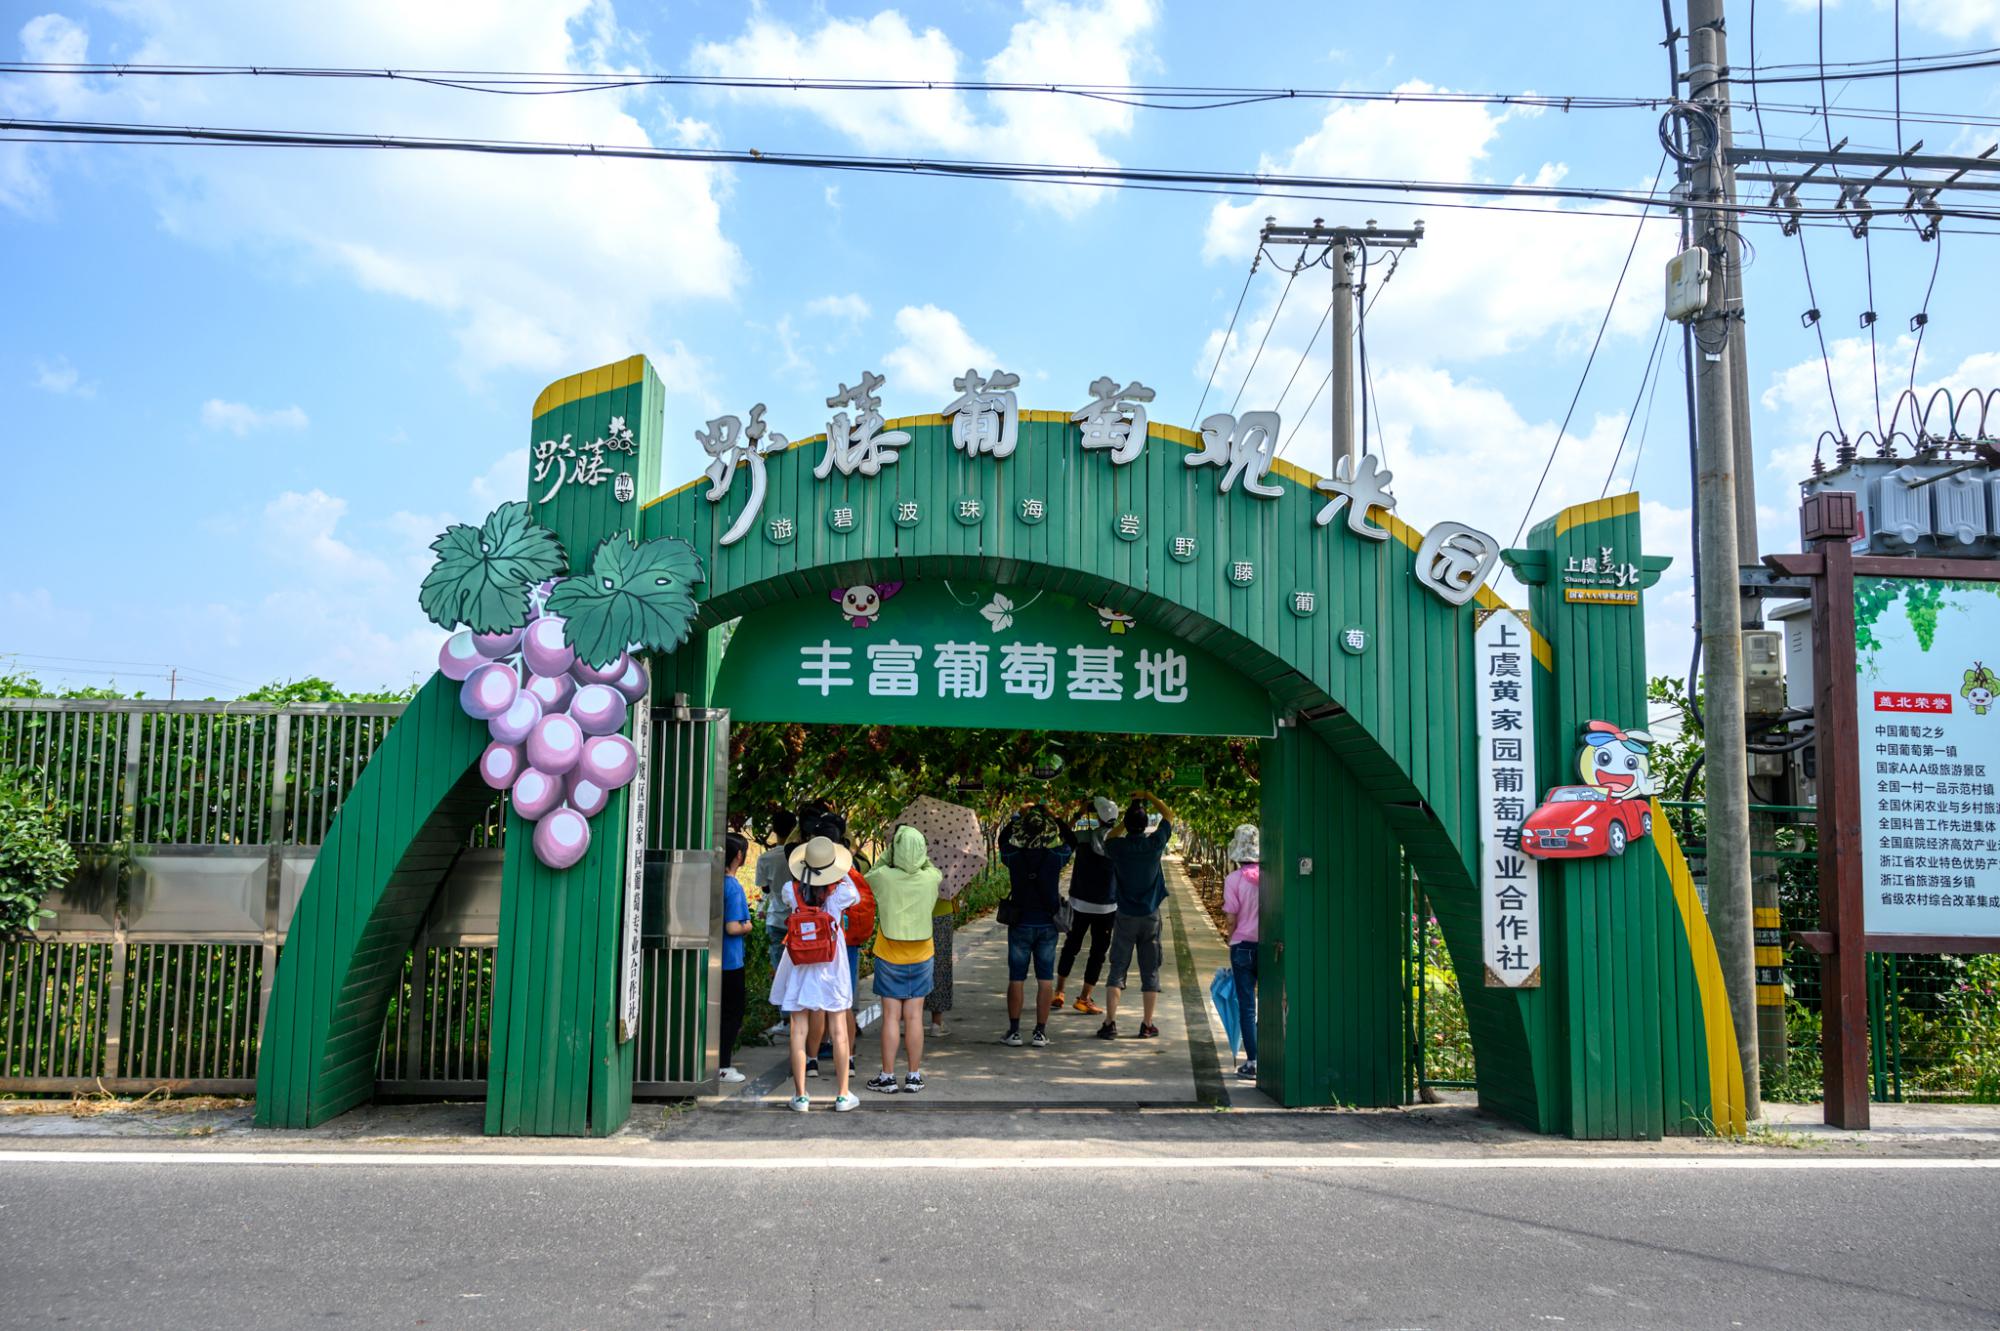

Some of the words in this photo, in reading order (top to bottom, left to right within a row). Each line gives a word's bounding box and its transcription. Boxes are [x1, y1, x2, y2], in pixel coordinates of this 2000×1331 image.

[695, 368, 1501, 606] 野藤葡萄观光园
[797, 639, 1188, 703] 丰富葡萄基地
[1879, 695, 1947, 710] 盖北荣誉
[1875, 724, 1944, 738] 中国葡萄之乡
[1876, 743, 1957, 757] 中国葡萄第一镇
[1876, 762, 1986, 777] 国家AAA级旅游景区
[1877, 780, 1994, 796] 全国一村一品示范村镇
[1488, 624, 1529, 970] 上虞黄家园葡萄专业合作社
[1879, 817, 1996, 832] 全国科普工作先进集体
[1880, 836, 2000, 851] 全国庭院经济高效产业
[1880, 855, 2000, 870] 浙江省农业特色优势产
[1880, 874, 1976, 888] 浙江省旅游强乡镇
